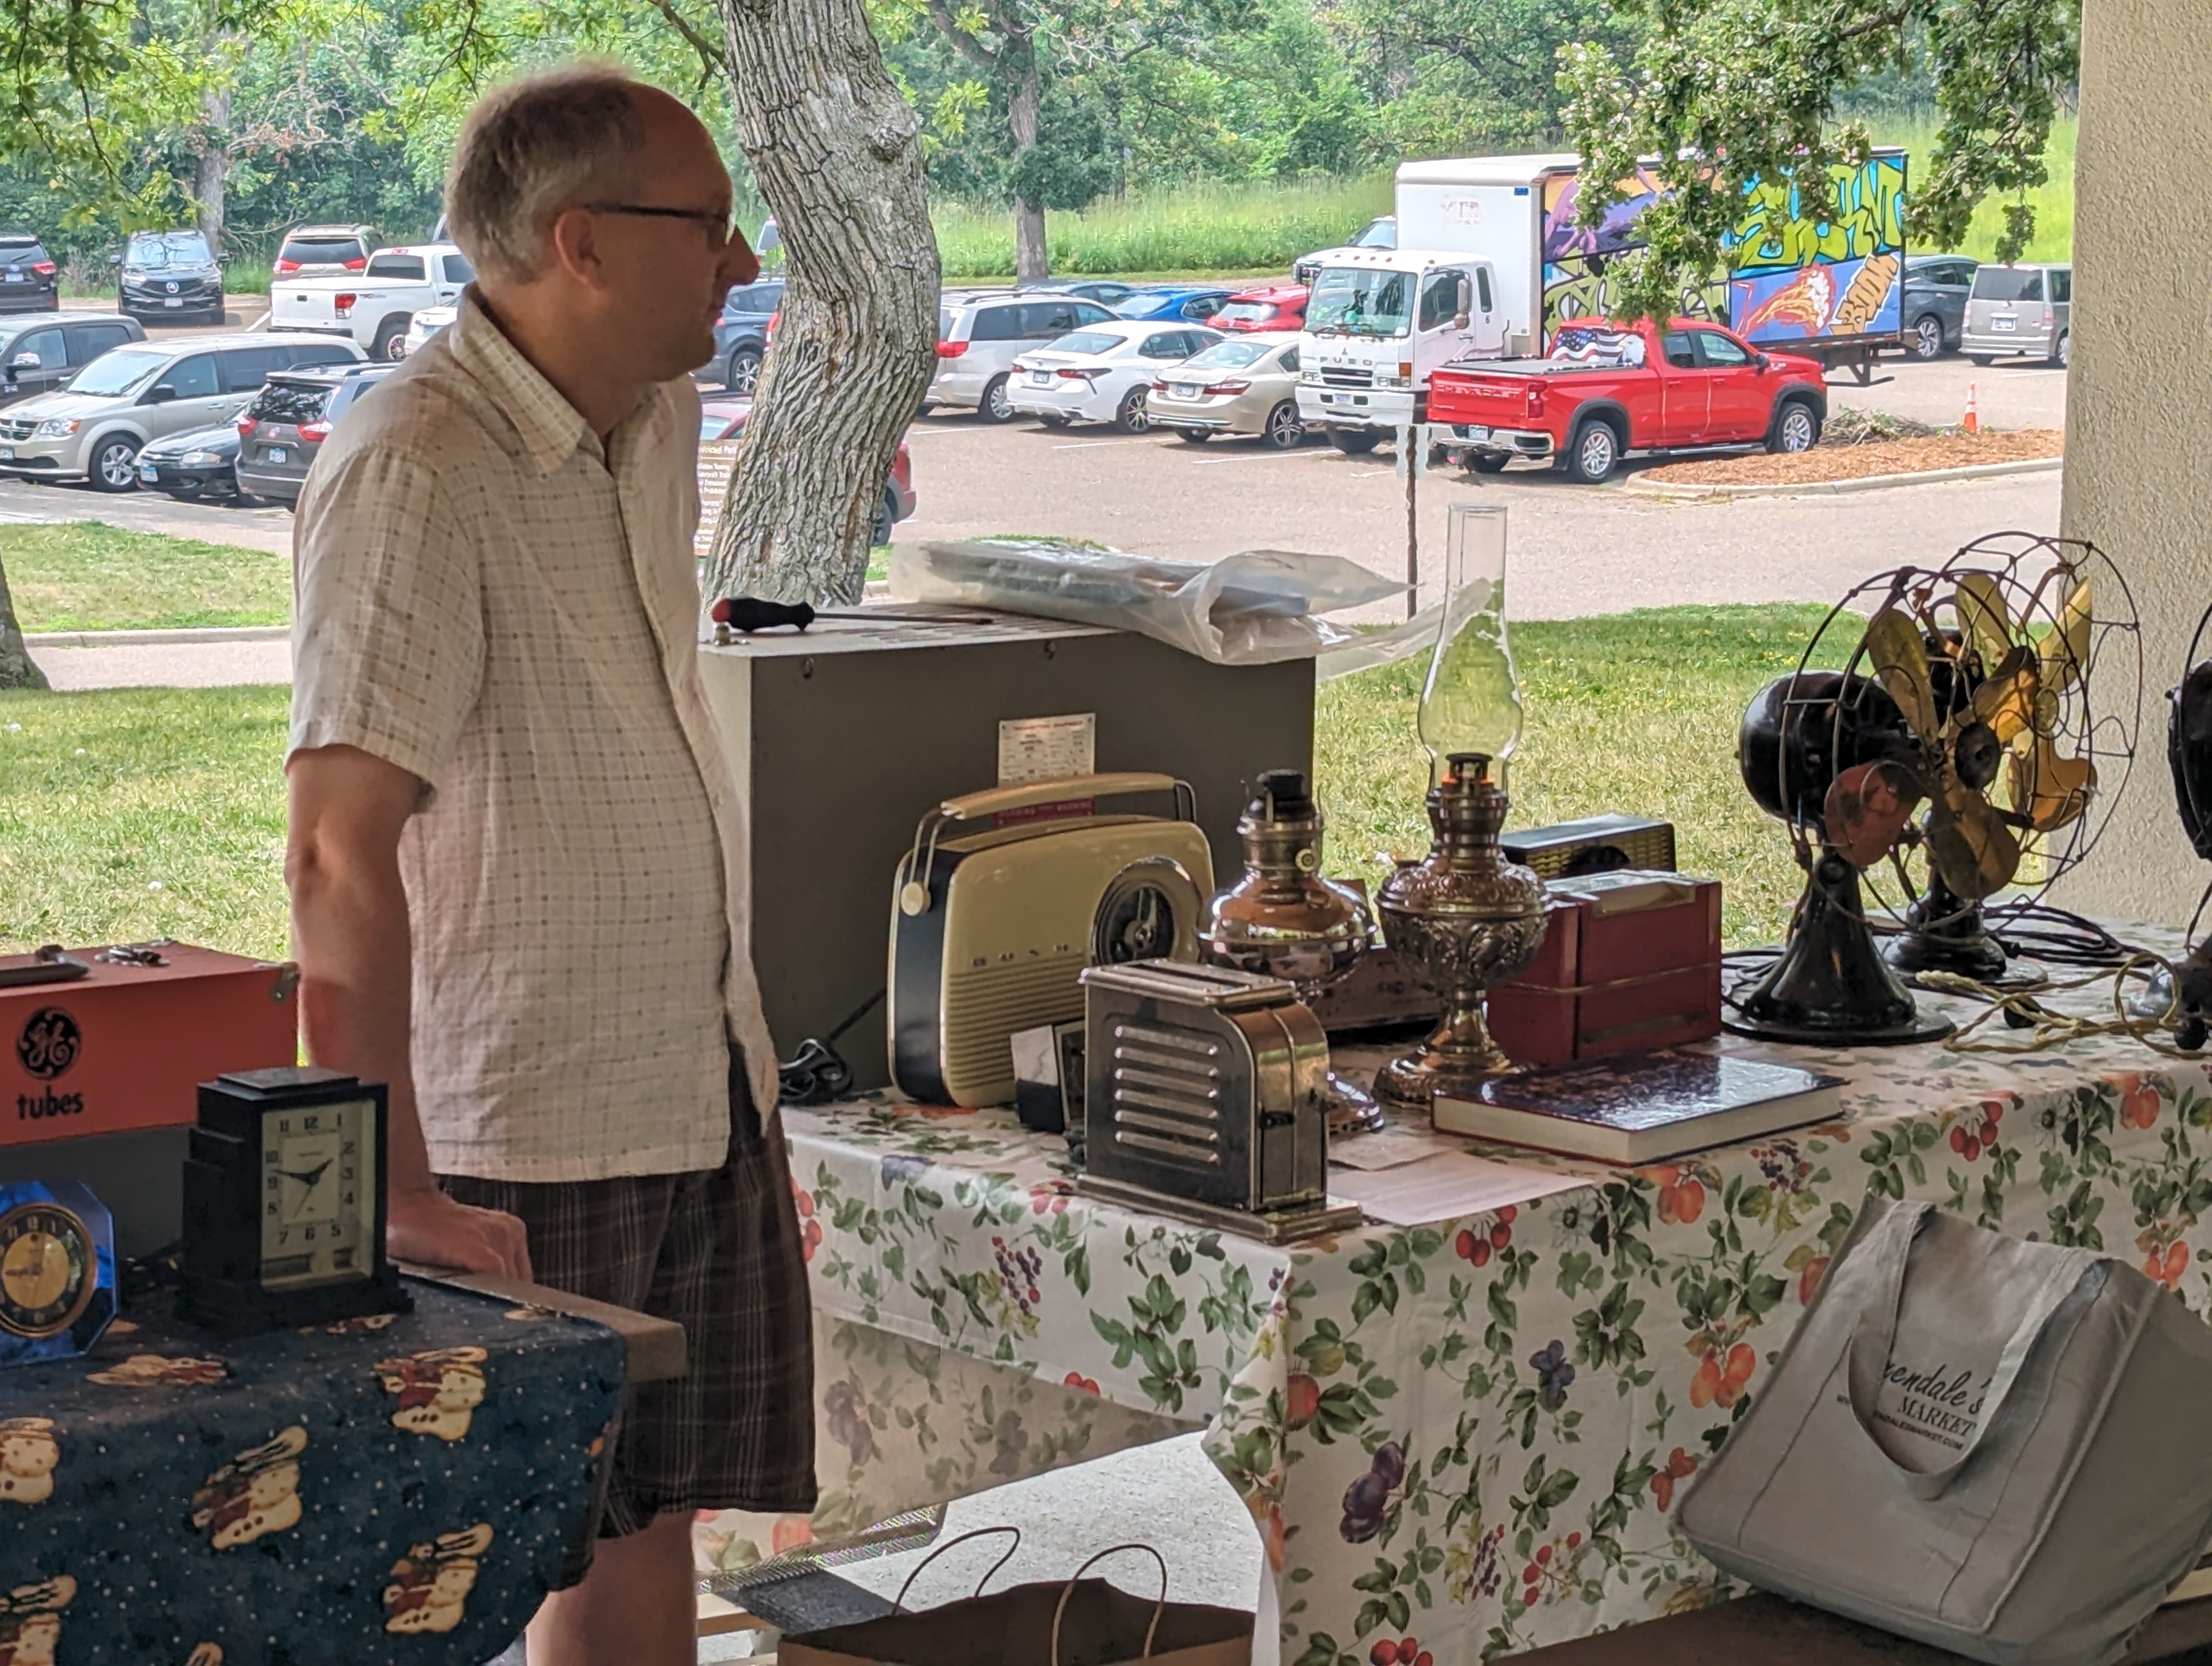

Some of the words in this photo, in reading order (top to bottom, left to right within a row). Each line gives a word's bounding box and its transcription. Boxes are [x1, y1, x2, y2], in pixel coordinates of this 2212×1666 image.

[1829, 253, 1898, 335] BOOM
[1486, 315, 1490, 324] 6
[1437, 384, 1520, 398] CHEVROLET
[17, 1085, 83, 1120] tubes
[304, 1116, 318, 1130] 12
[344, 1140, 355, 1154] 2
[1897, 1396, 1977, 1437] MARKET
